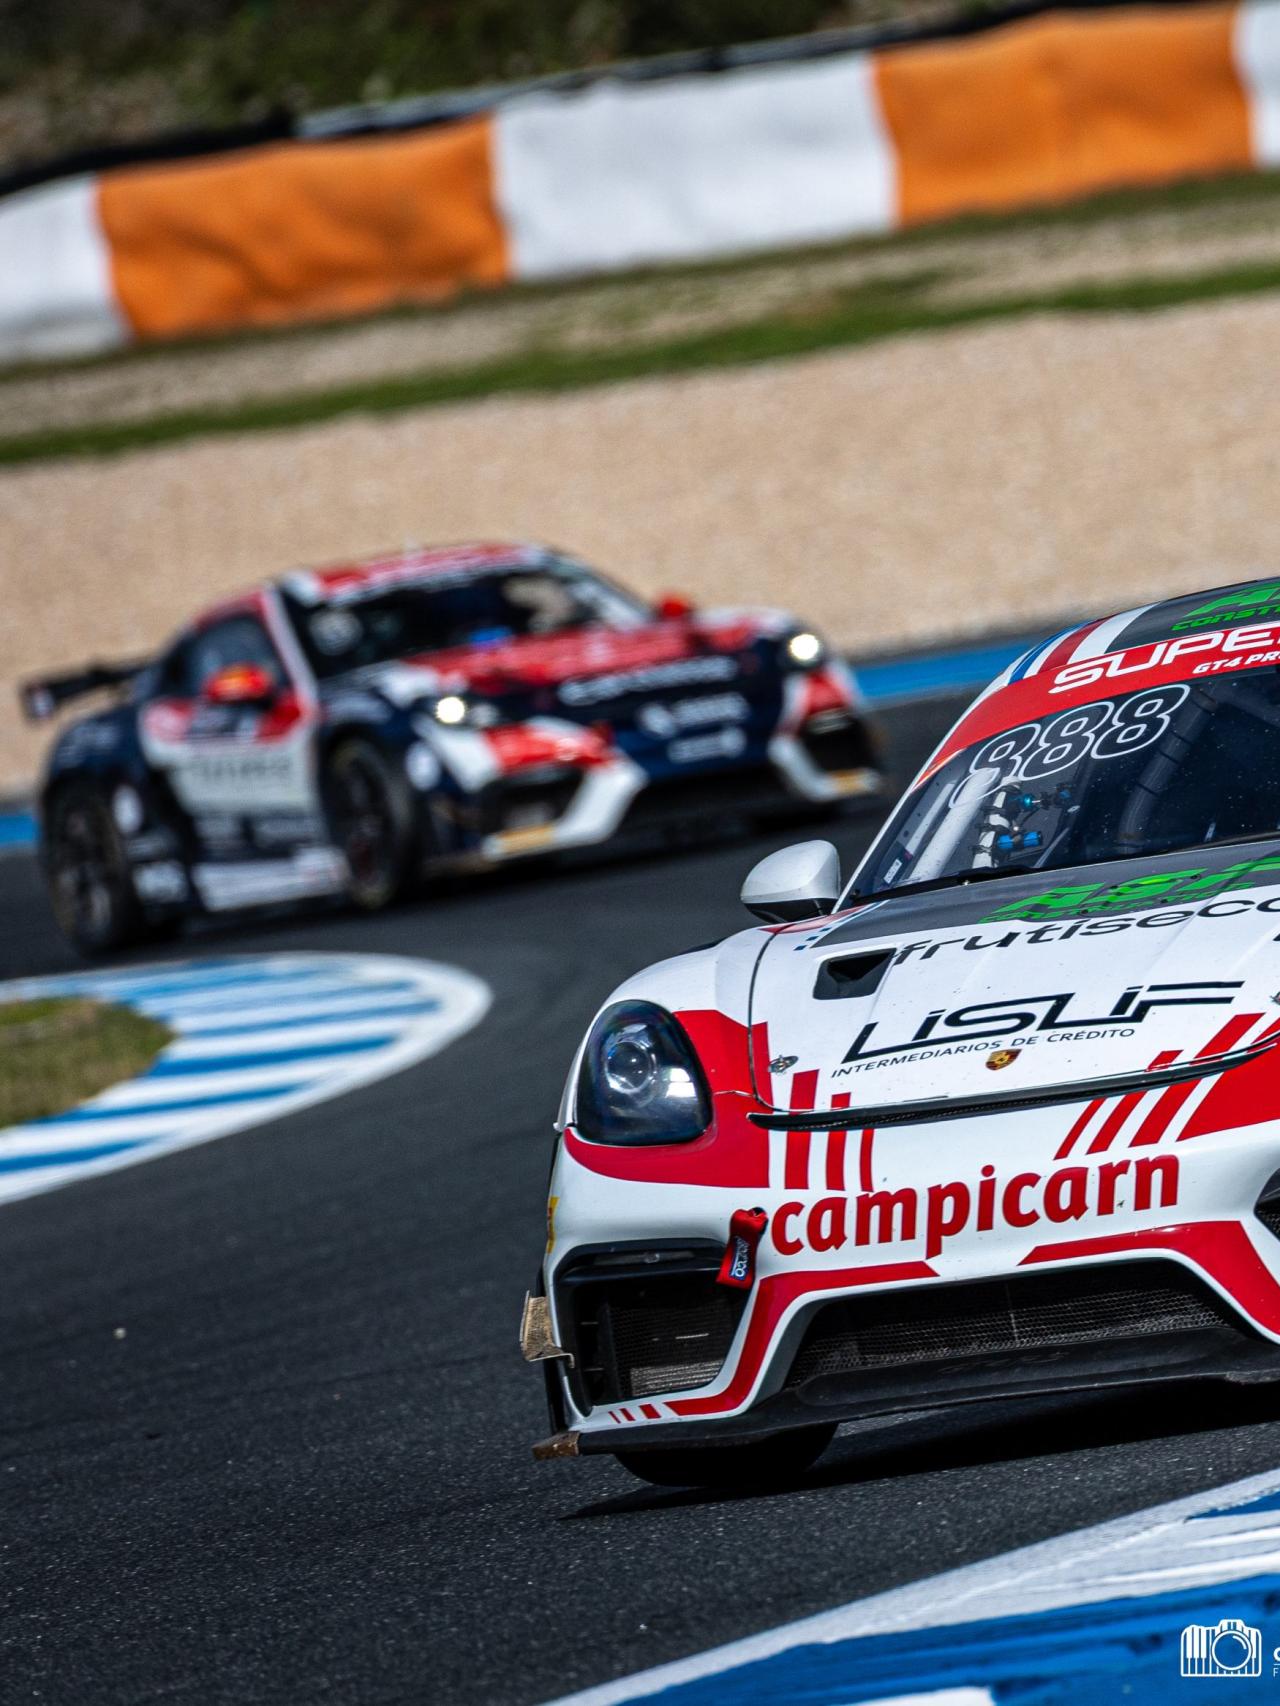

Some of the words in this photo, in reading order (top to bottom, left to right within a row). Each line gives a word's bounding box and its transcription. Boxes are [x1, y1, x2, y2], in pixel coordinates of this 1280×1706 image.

[1192, 655, 1241, 675] GT4
[949, 683, 1190, 808] 888
[832, 1039, 1001, 1078] INTERMEDIARIOS
[1011, 1035, 1037, 1046] DE
[1047, 1028, 1135, 1043] CRÉDITO
[771, 1154, 1180, 1260] campicarn
